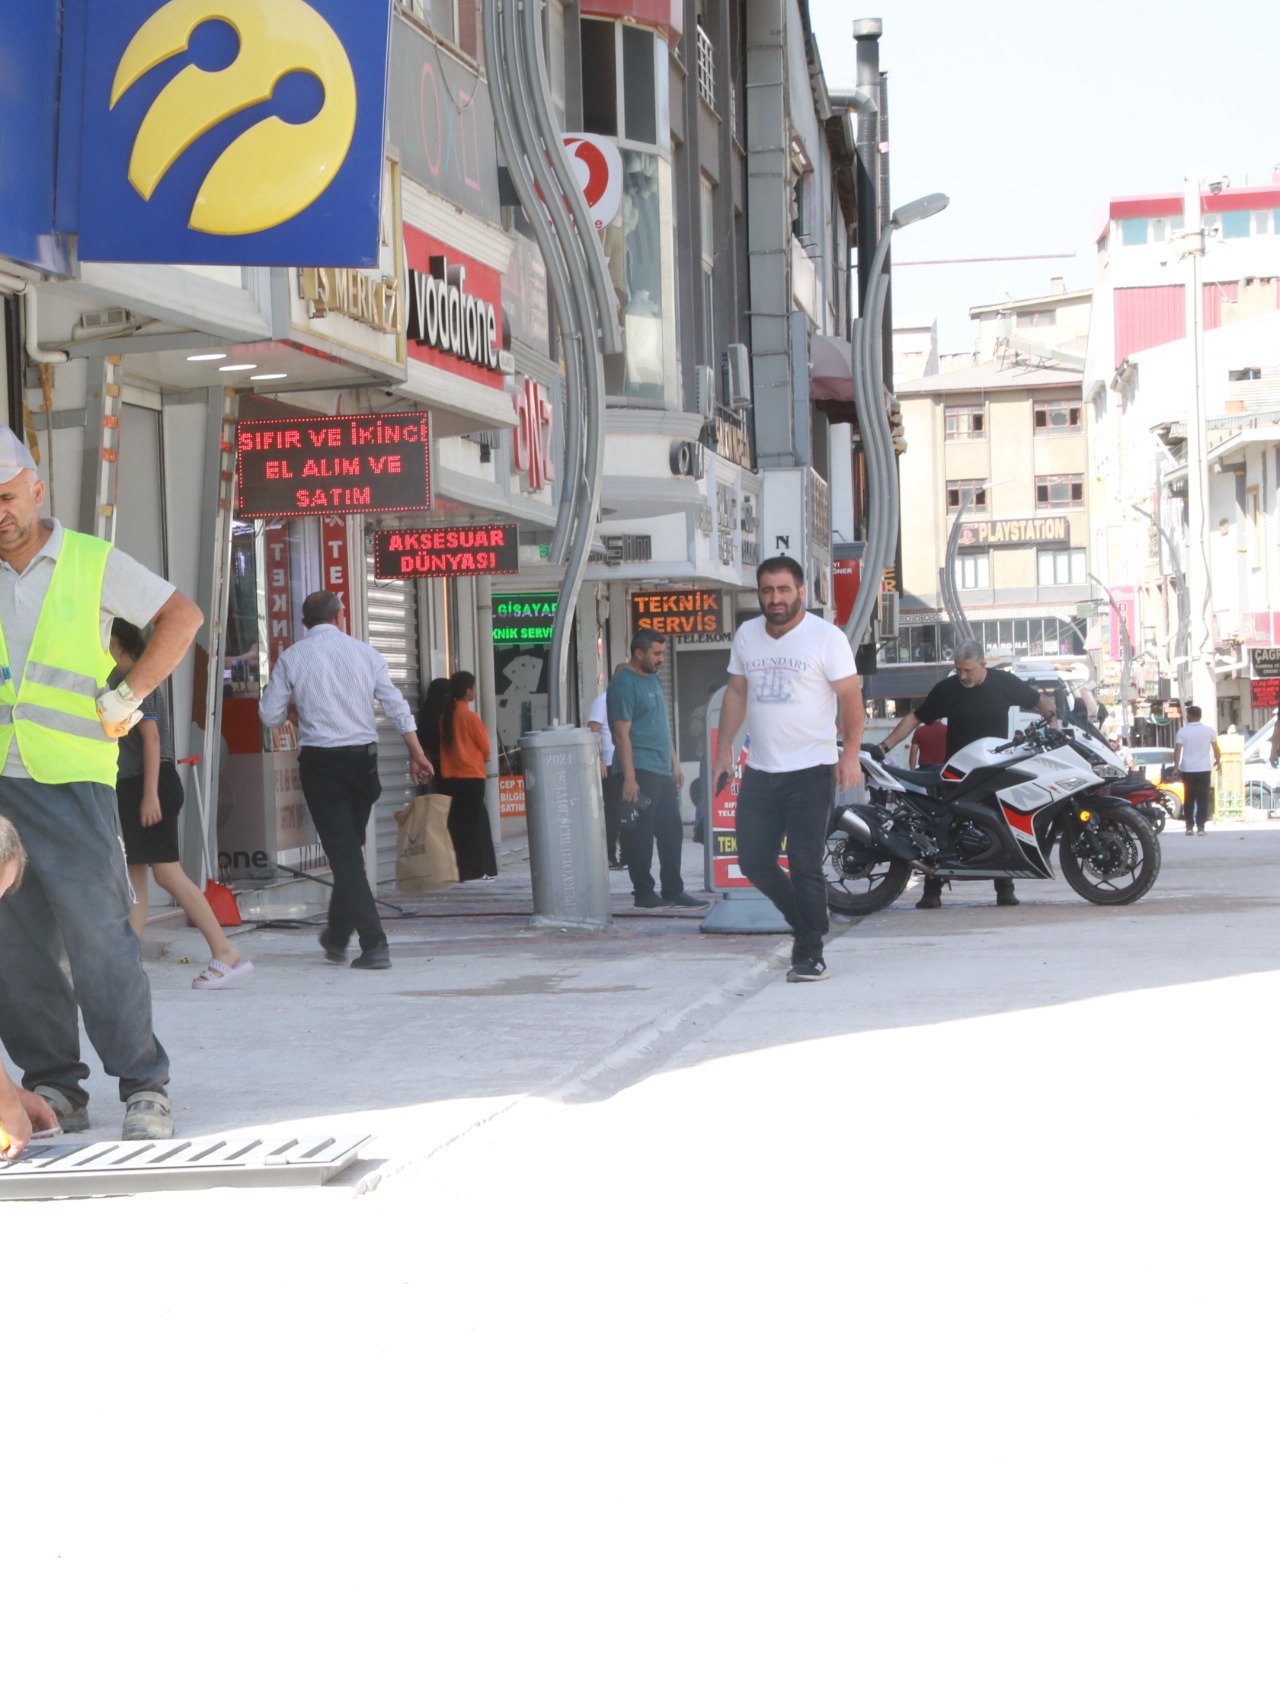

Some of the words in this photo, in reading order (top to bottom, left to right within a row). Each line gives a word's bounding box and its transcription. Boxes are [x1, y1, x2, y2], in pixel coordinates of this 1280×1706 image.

[413, 256, 498, 369] vodafone
[239, 430, 302, 451] SIFIR
[308, 428, 342, 447] VE
[265, 460, 294, 479] EL
[301, 457, 361, 478] ALIM
[368, 455, 402, 474] VE
[295, 486, 371, 507] SATIM
[388, 529, 505, 552] AKSESUAR
[400, 550, 497, 573] DÜNYASI
[634, 592, 720, 613] TEKNİK
[638, 611, 717, 633] SERVİS
[499, 780, 516, 789] CEP
[500, 803, 525, 813] SATIM
